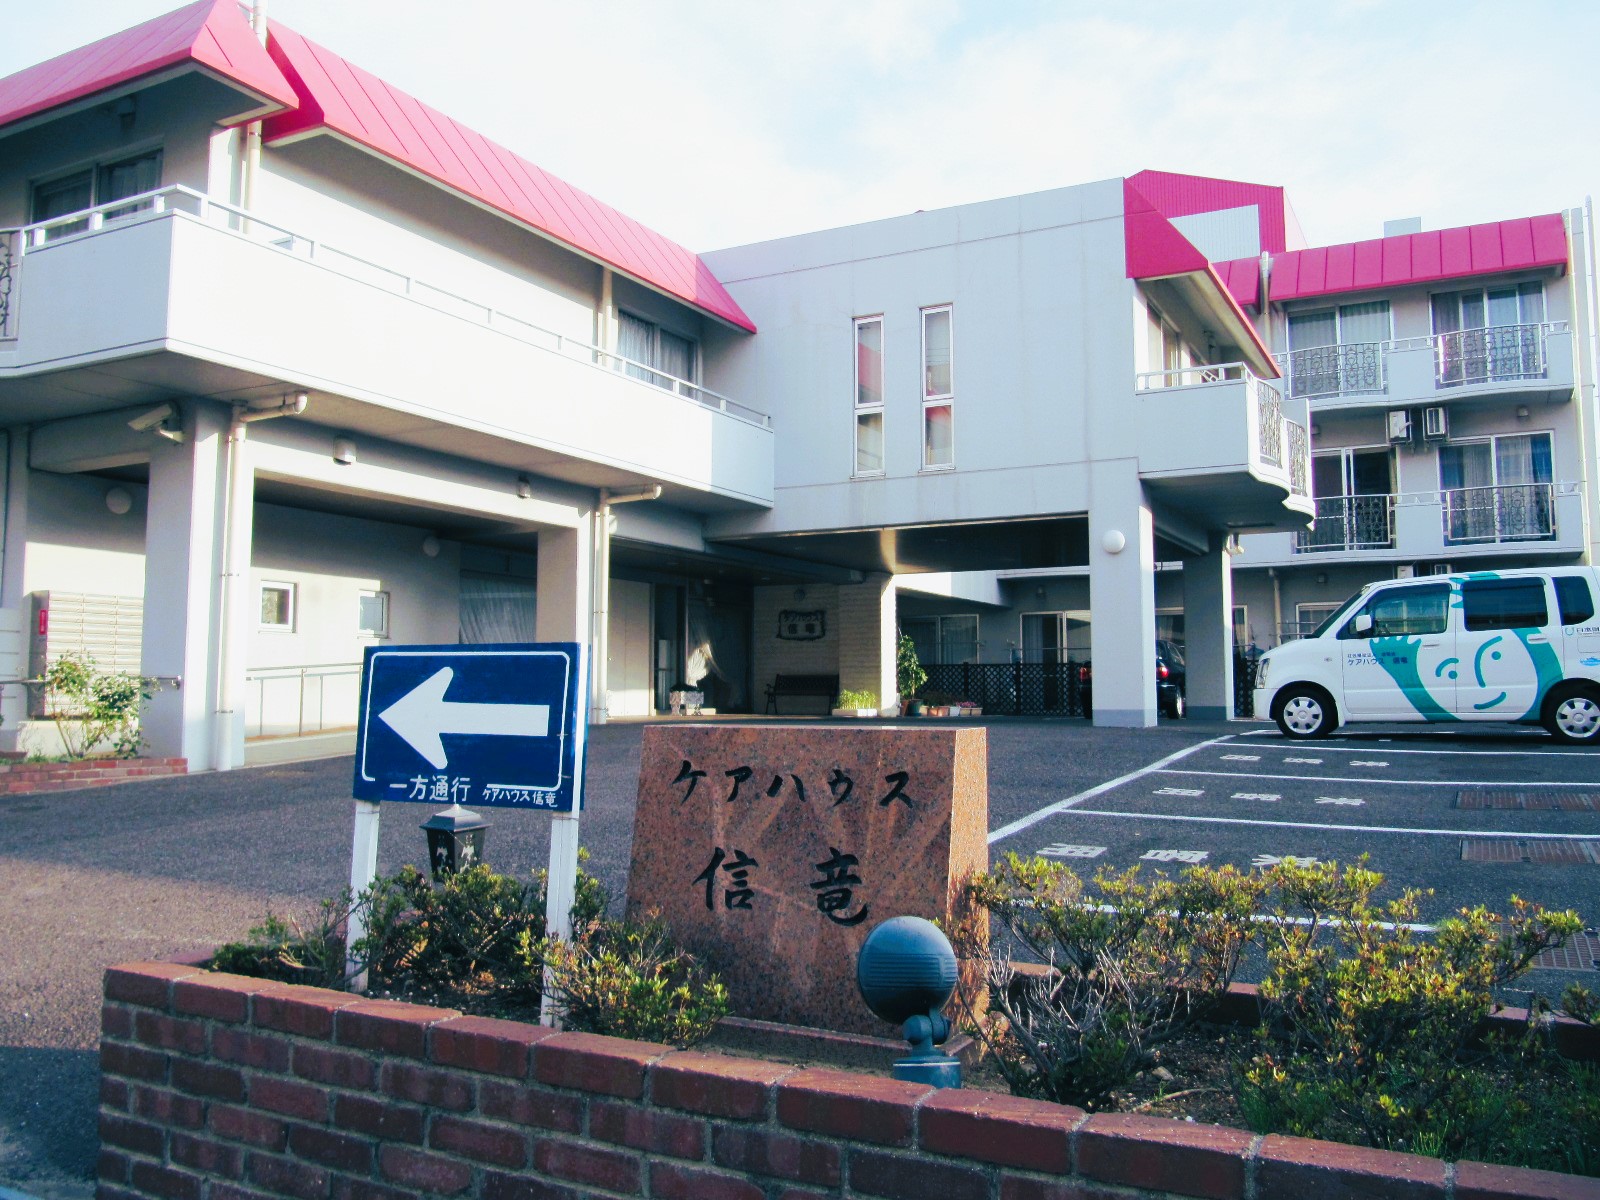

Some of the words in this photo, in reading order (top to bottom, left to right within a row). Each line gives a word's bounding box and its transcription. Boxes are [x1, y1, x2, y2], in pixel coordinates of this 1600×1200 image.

[1347, 657, 1385, 666] ケアハウス
[389, 774, 471, 802] 一方通行
[671, 760, 914, 809] ケアハウス
[692, 846, 868, 927] 信竜
